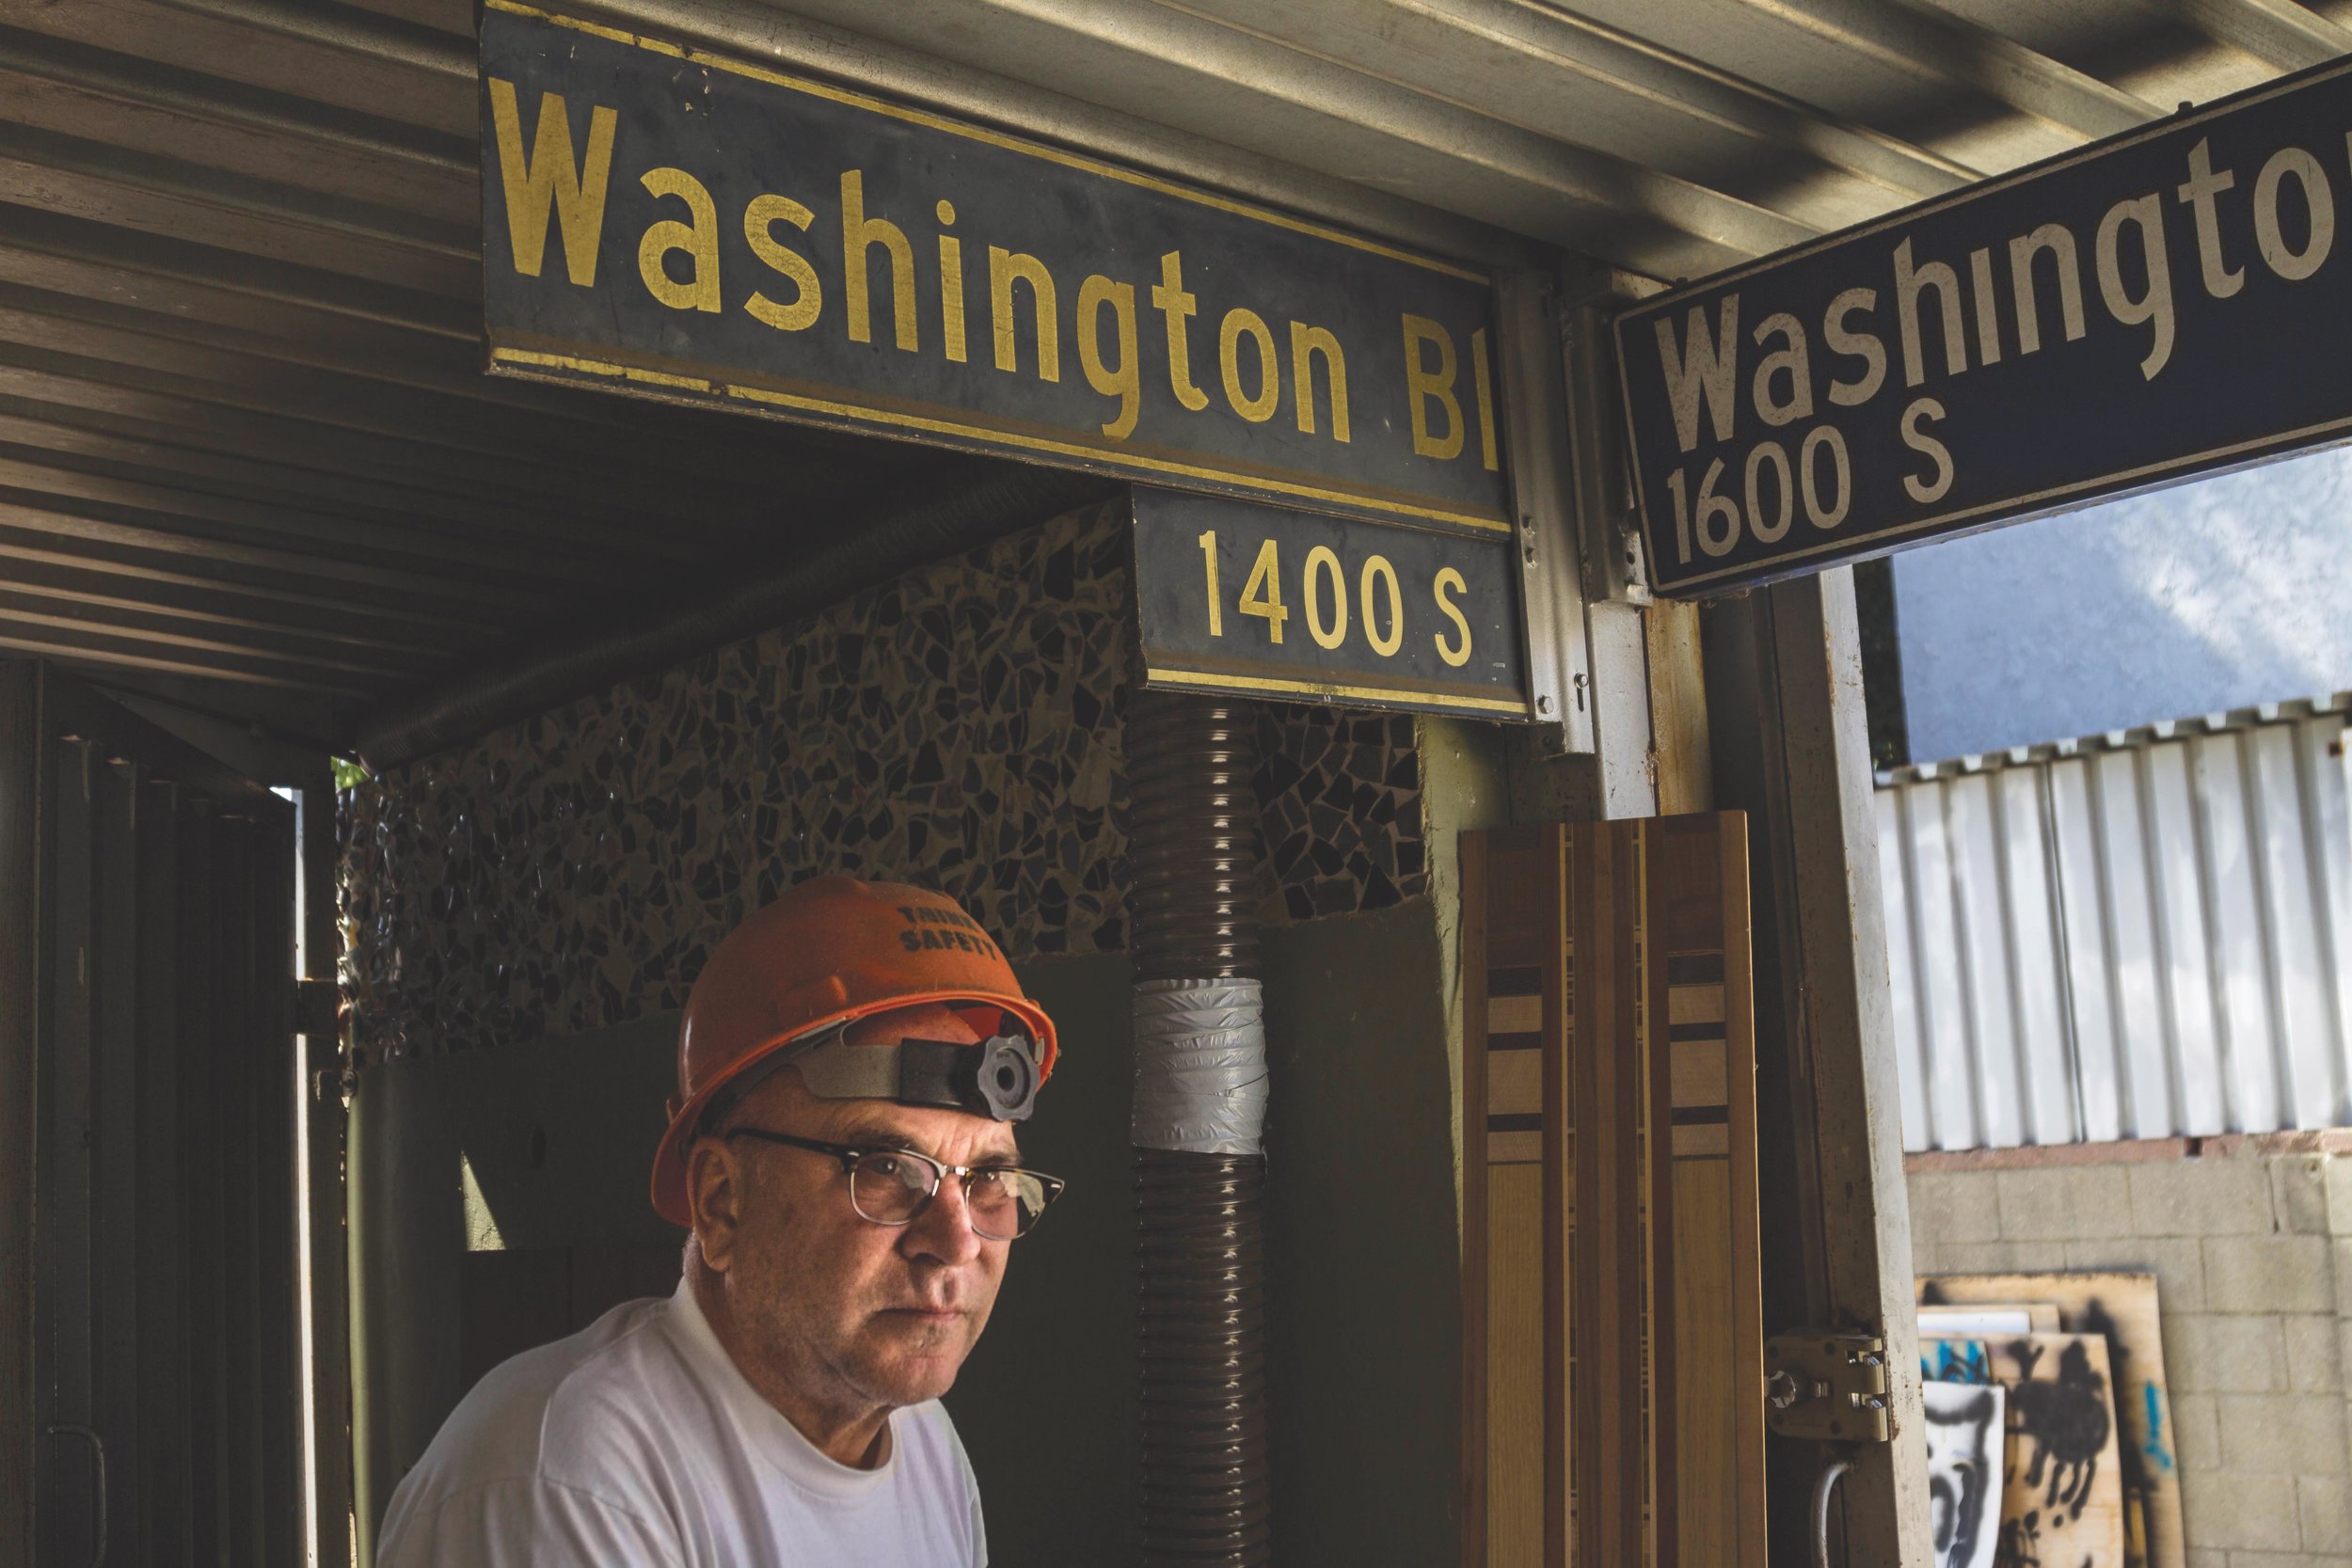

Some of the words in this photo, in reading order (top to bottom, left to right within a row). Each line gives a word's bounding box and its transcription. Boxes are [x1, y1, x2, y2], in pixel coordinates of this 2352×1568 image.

[487, 76, 1351, 443] Washington
[1402, 312, 1499, 471] Bl
[1653, 130, 2352, 453] Washingto
[1666, 424, 1851, 564] 1600
[1900, 397, 1955, 504] S
[1199, 530, 1404, 657] 1400
[1433, 566, 1473, 667] S
[899, 928, 997, 960] SAFETY
